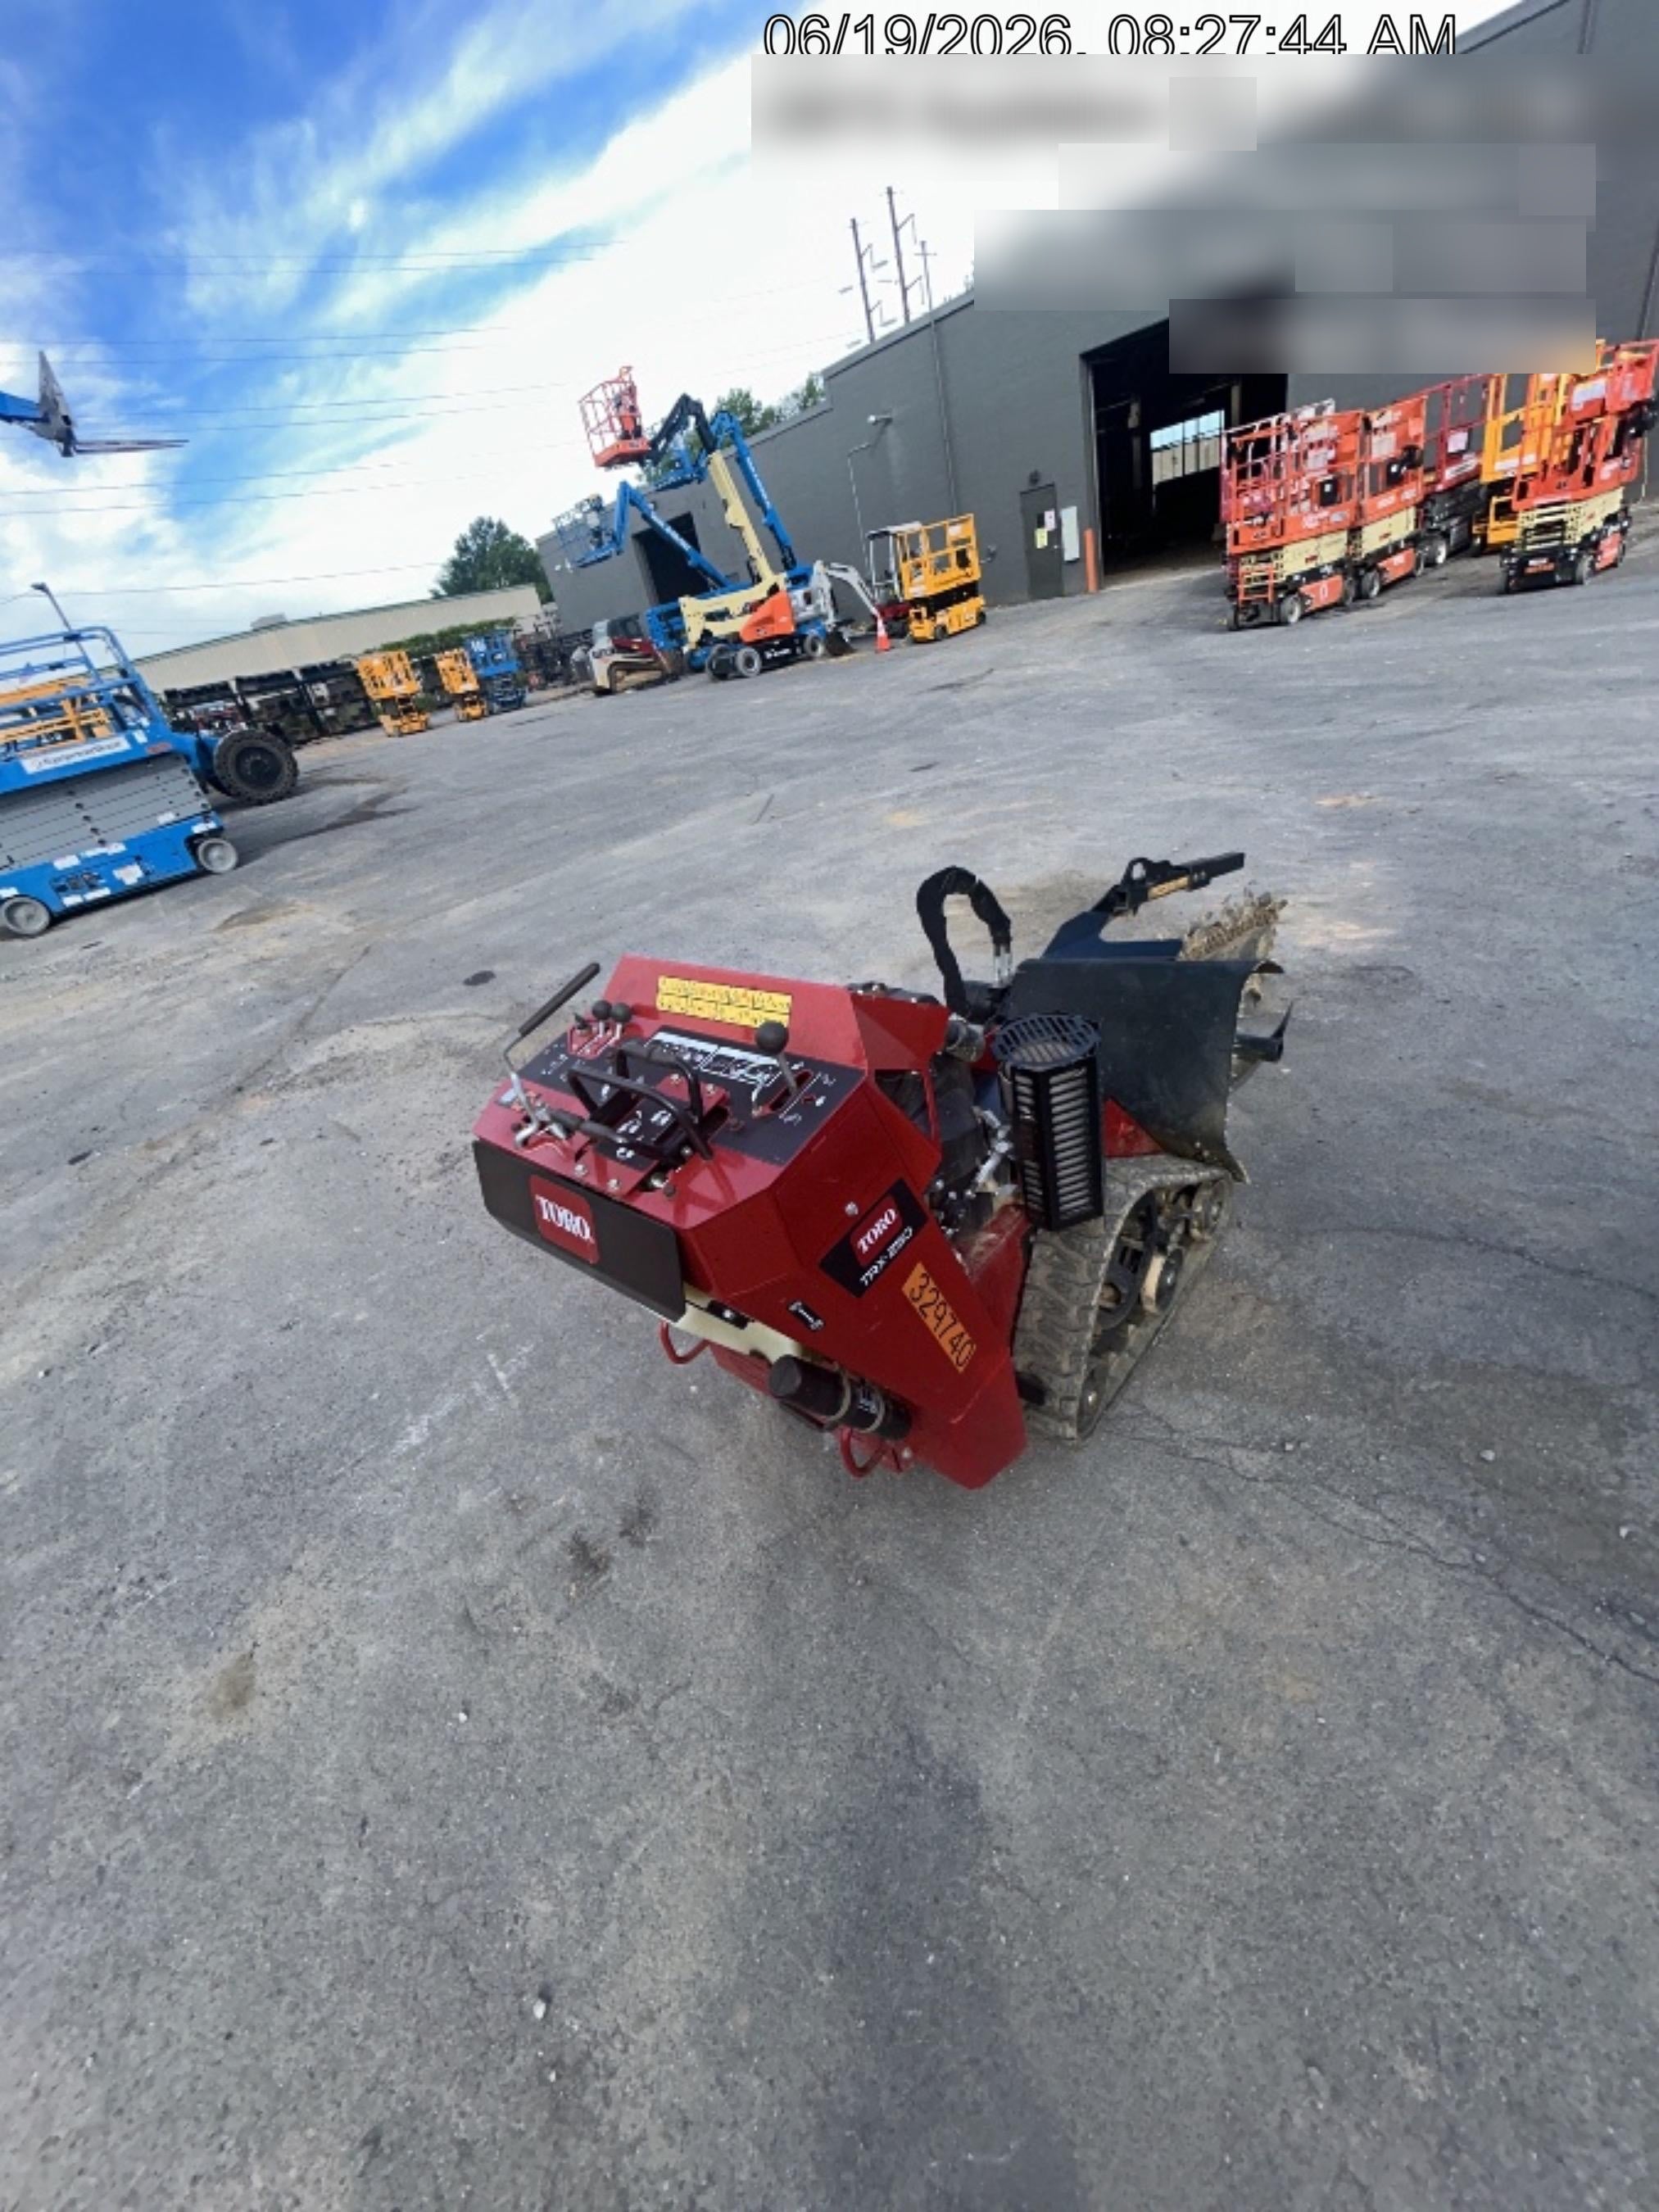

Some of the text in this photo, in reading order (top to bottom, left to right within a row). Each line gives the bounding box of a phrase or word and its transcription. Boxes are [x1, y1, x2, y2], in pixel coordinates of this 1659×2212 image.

[535, 1194, 593, 1242] TORO
[857, 1208, 898, 1254] TORO
[909, 1271, 977, 1368] 329740
